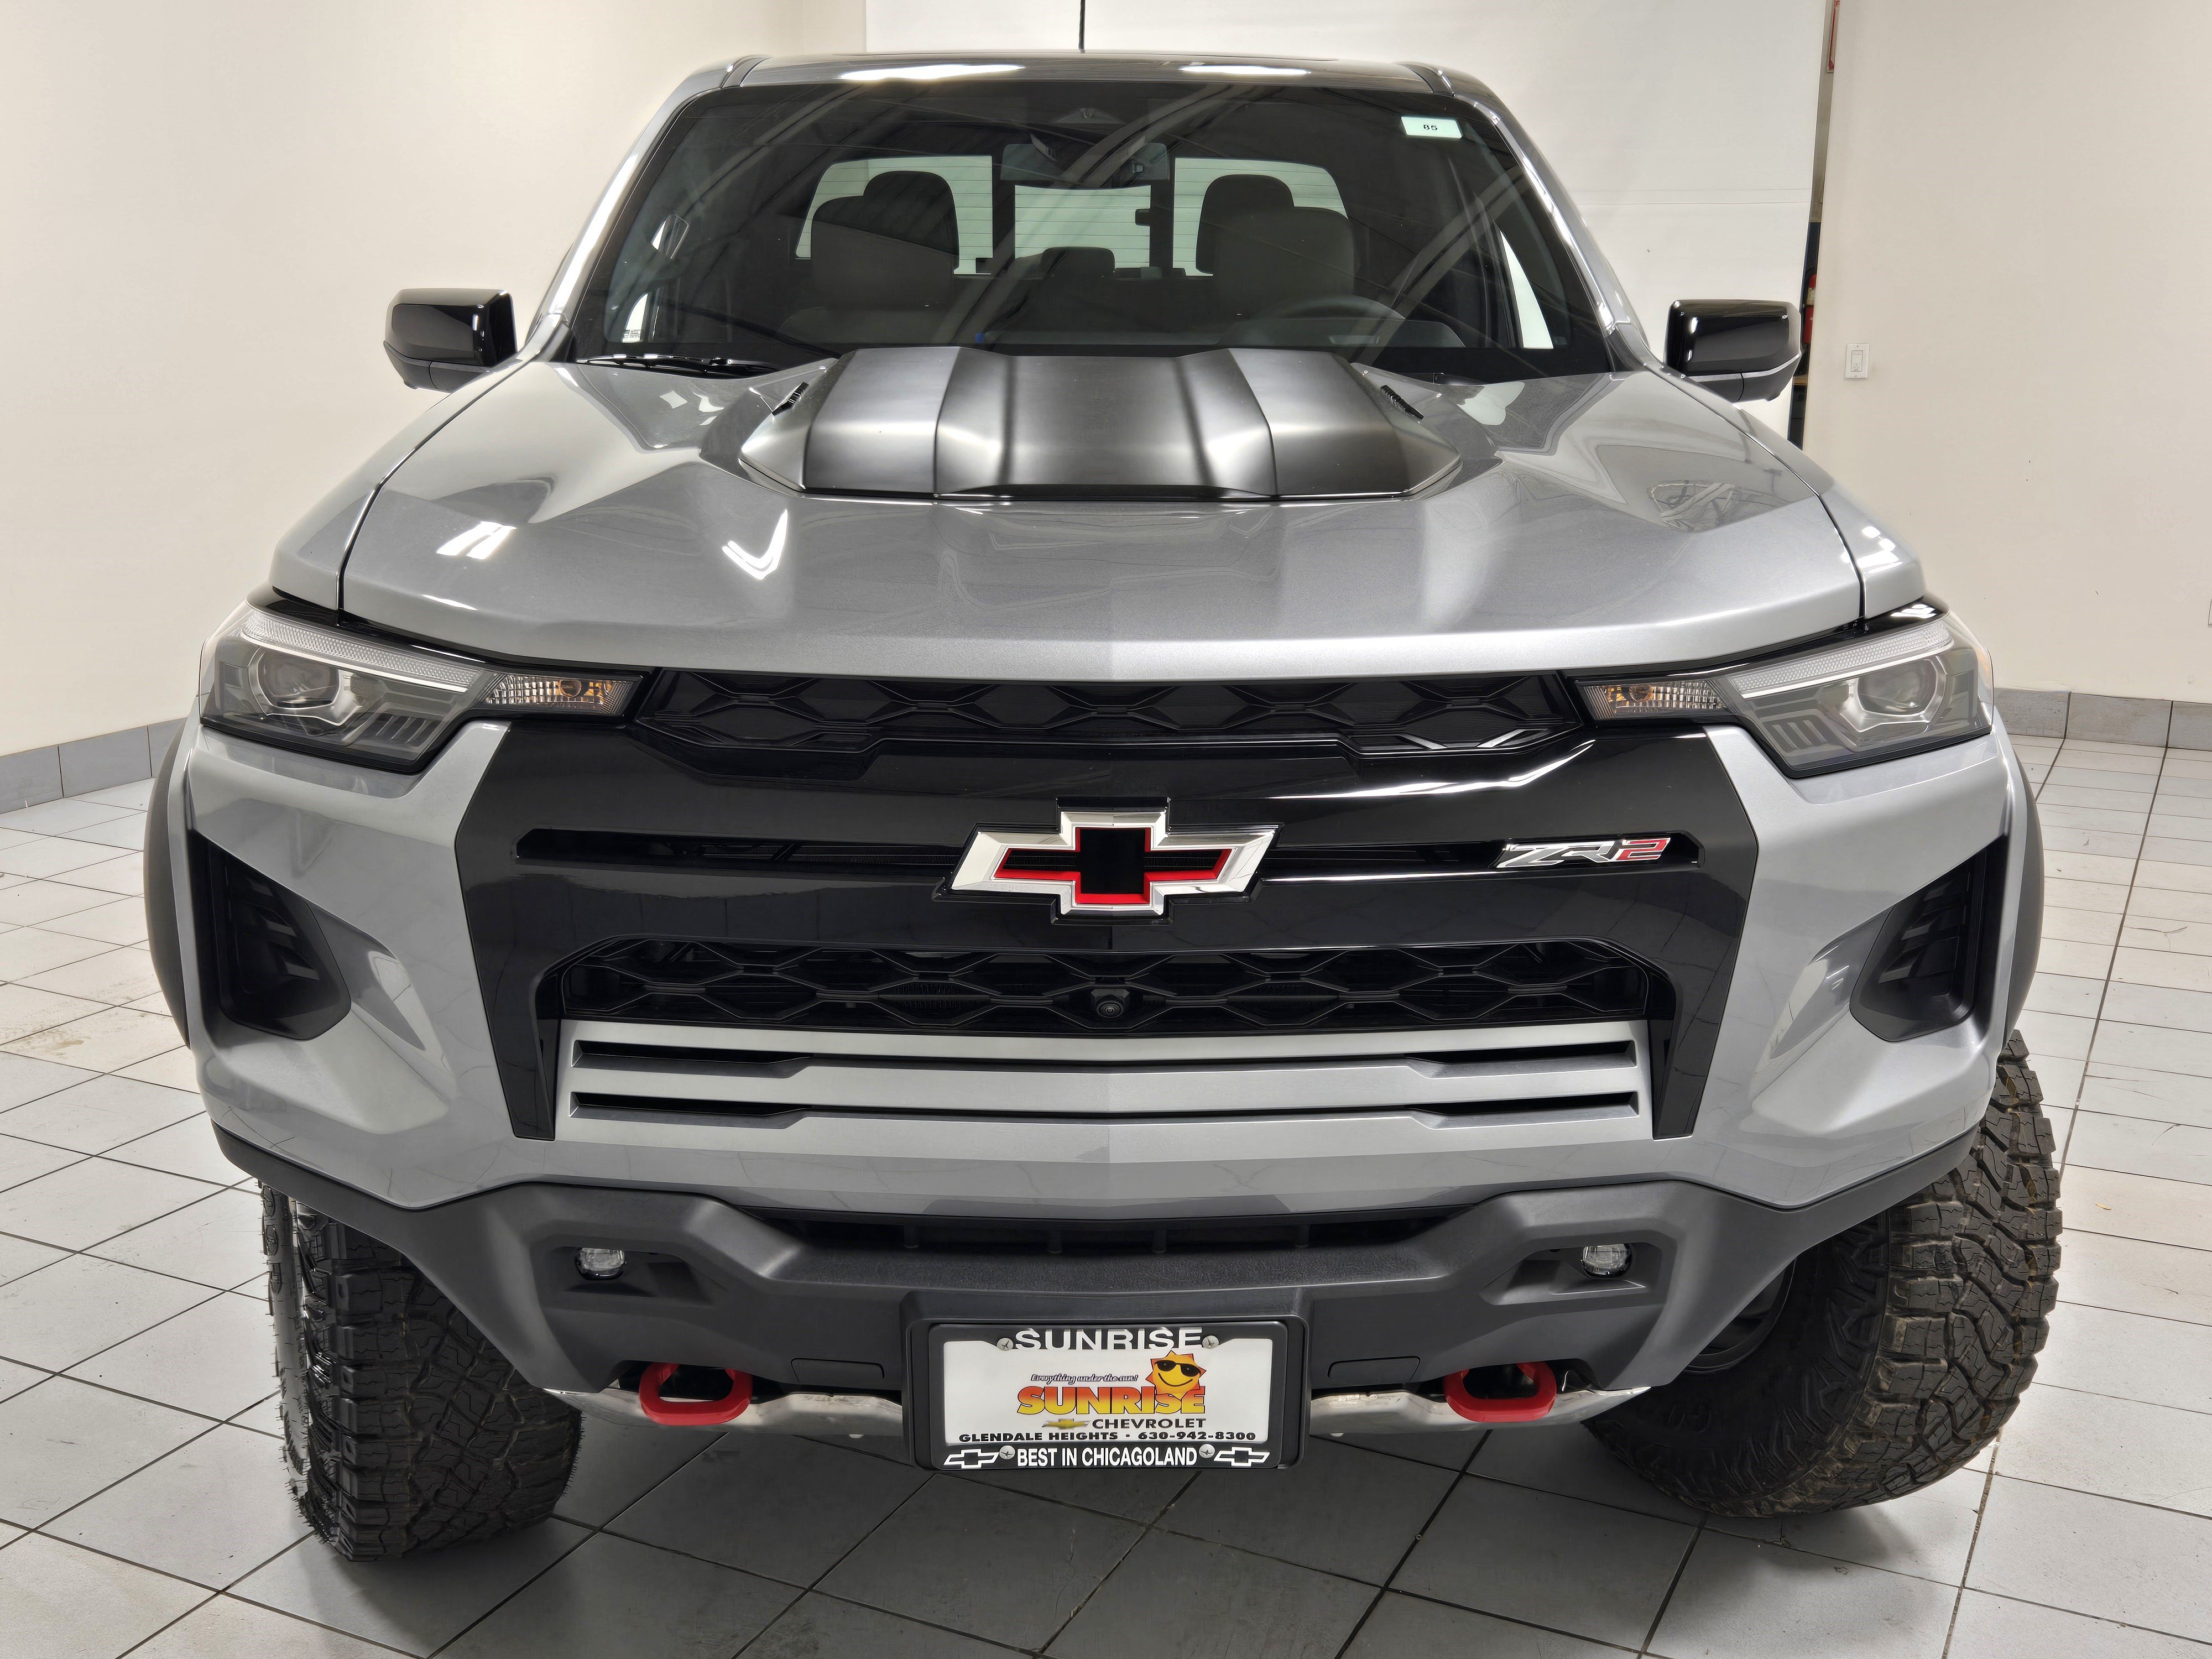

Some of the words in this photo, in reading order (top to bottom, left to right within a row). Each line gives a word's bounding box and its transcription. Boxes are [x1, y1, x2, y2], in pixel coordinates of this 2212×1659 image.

[1496, 837, 1671, 868] ZR2
[1015, 1327, 1202, 1350] SUNRISE
[1031, 1373, 1076, 1385] Everything
[1078, 1374, 1103, 1382] under
[1103, 1374, 1118, 1382] the
[1017, 1386, 1206, 1415] SUNRISE
[1092, 1418, 1206, 1429] CHEVROLET
[959, 1433, 1042, 1442] GLENDALE
[1138, 1432, 1256, 1440] 630-942-8300
[1018, 1448, 1057, 1466] BEST
[1062, 1448, 1077, 1466] IN
[1082, 1447, 1197, 1466] CHICAGOLAND
